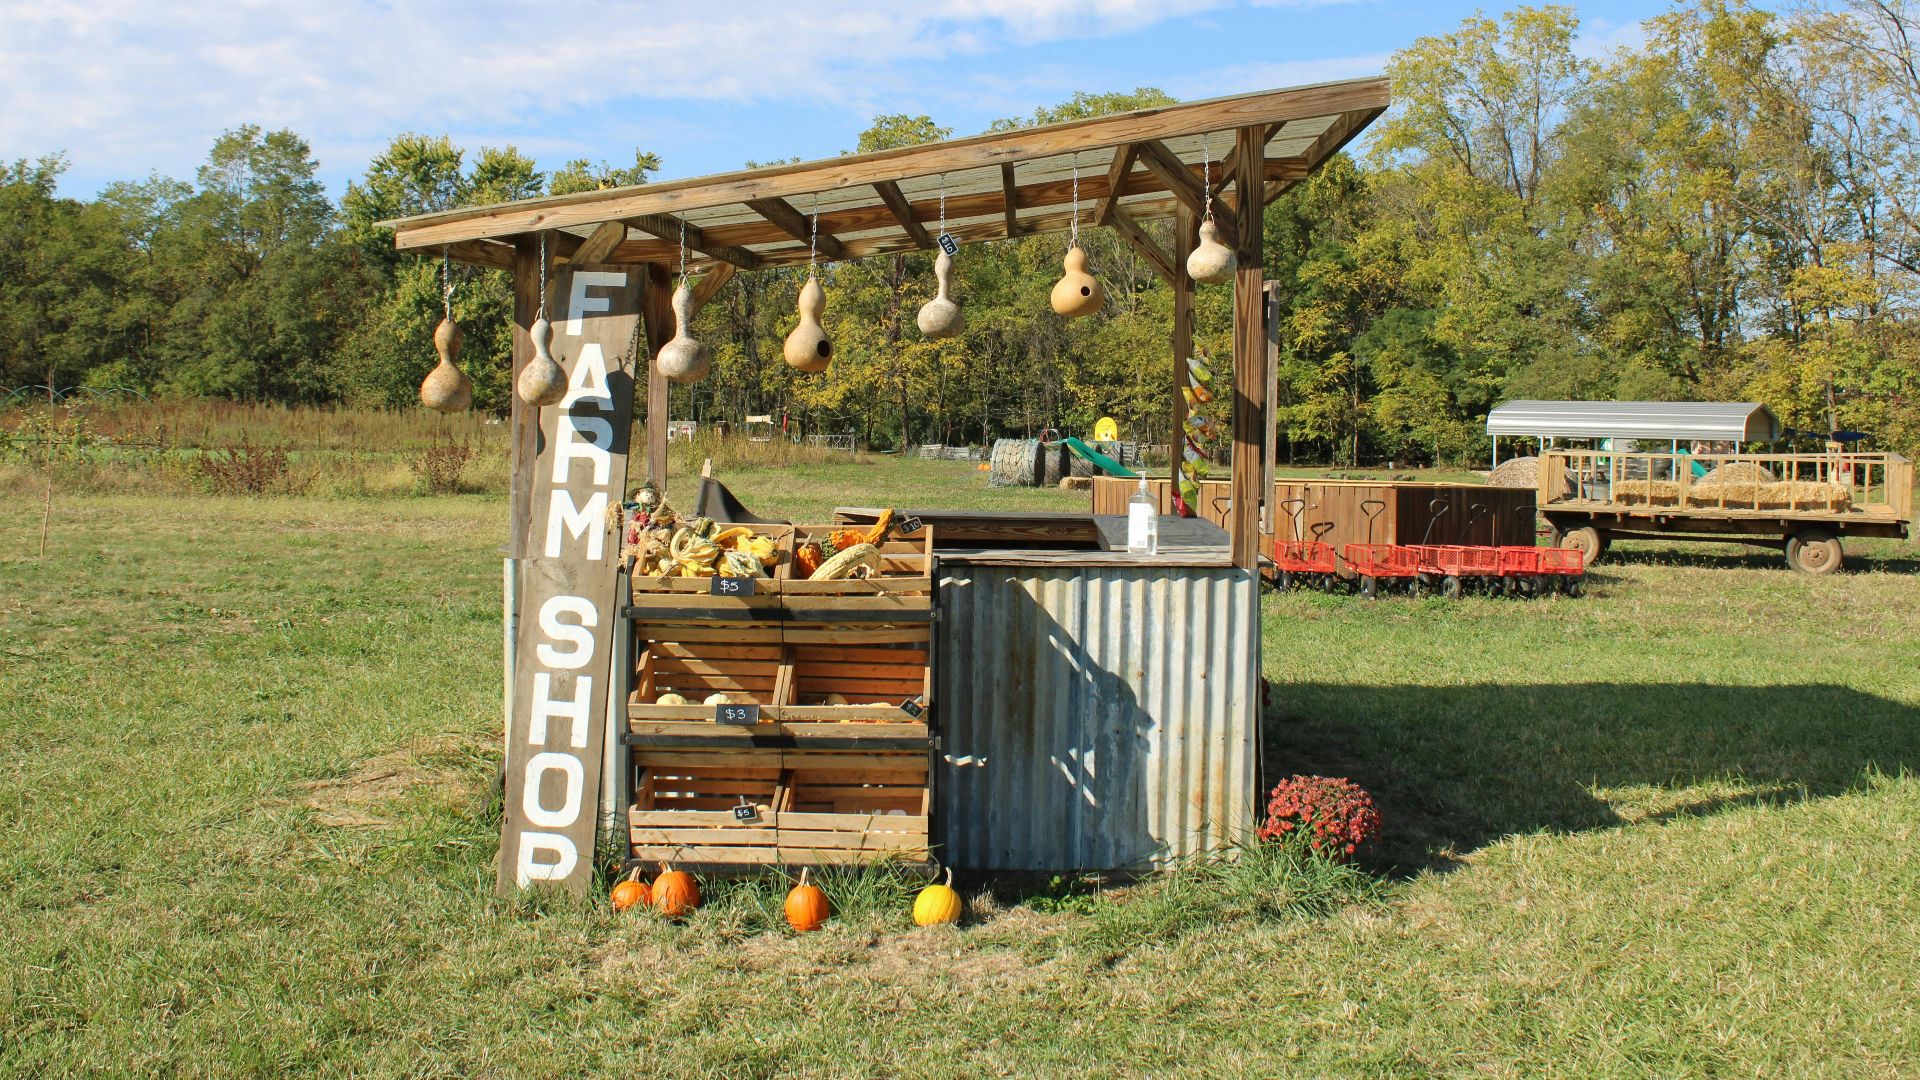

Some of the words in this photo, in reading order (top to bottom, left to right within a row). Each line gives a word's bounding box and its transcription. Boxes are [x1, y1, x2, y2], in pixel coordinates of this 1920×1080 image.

[942, 236, 953, 252] $10
[544, 271, 627, 561] FARM
[720, 579, 739, 593] $5
[725, 707, 746, 720] $3
[516, 595, 598, 888] SHOP
[737, 809, 750, 818] $5
